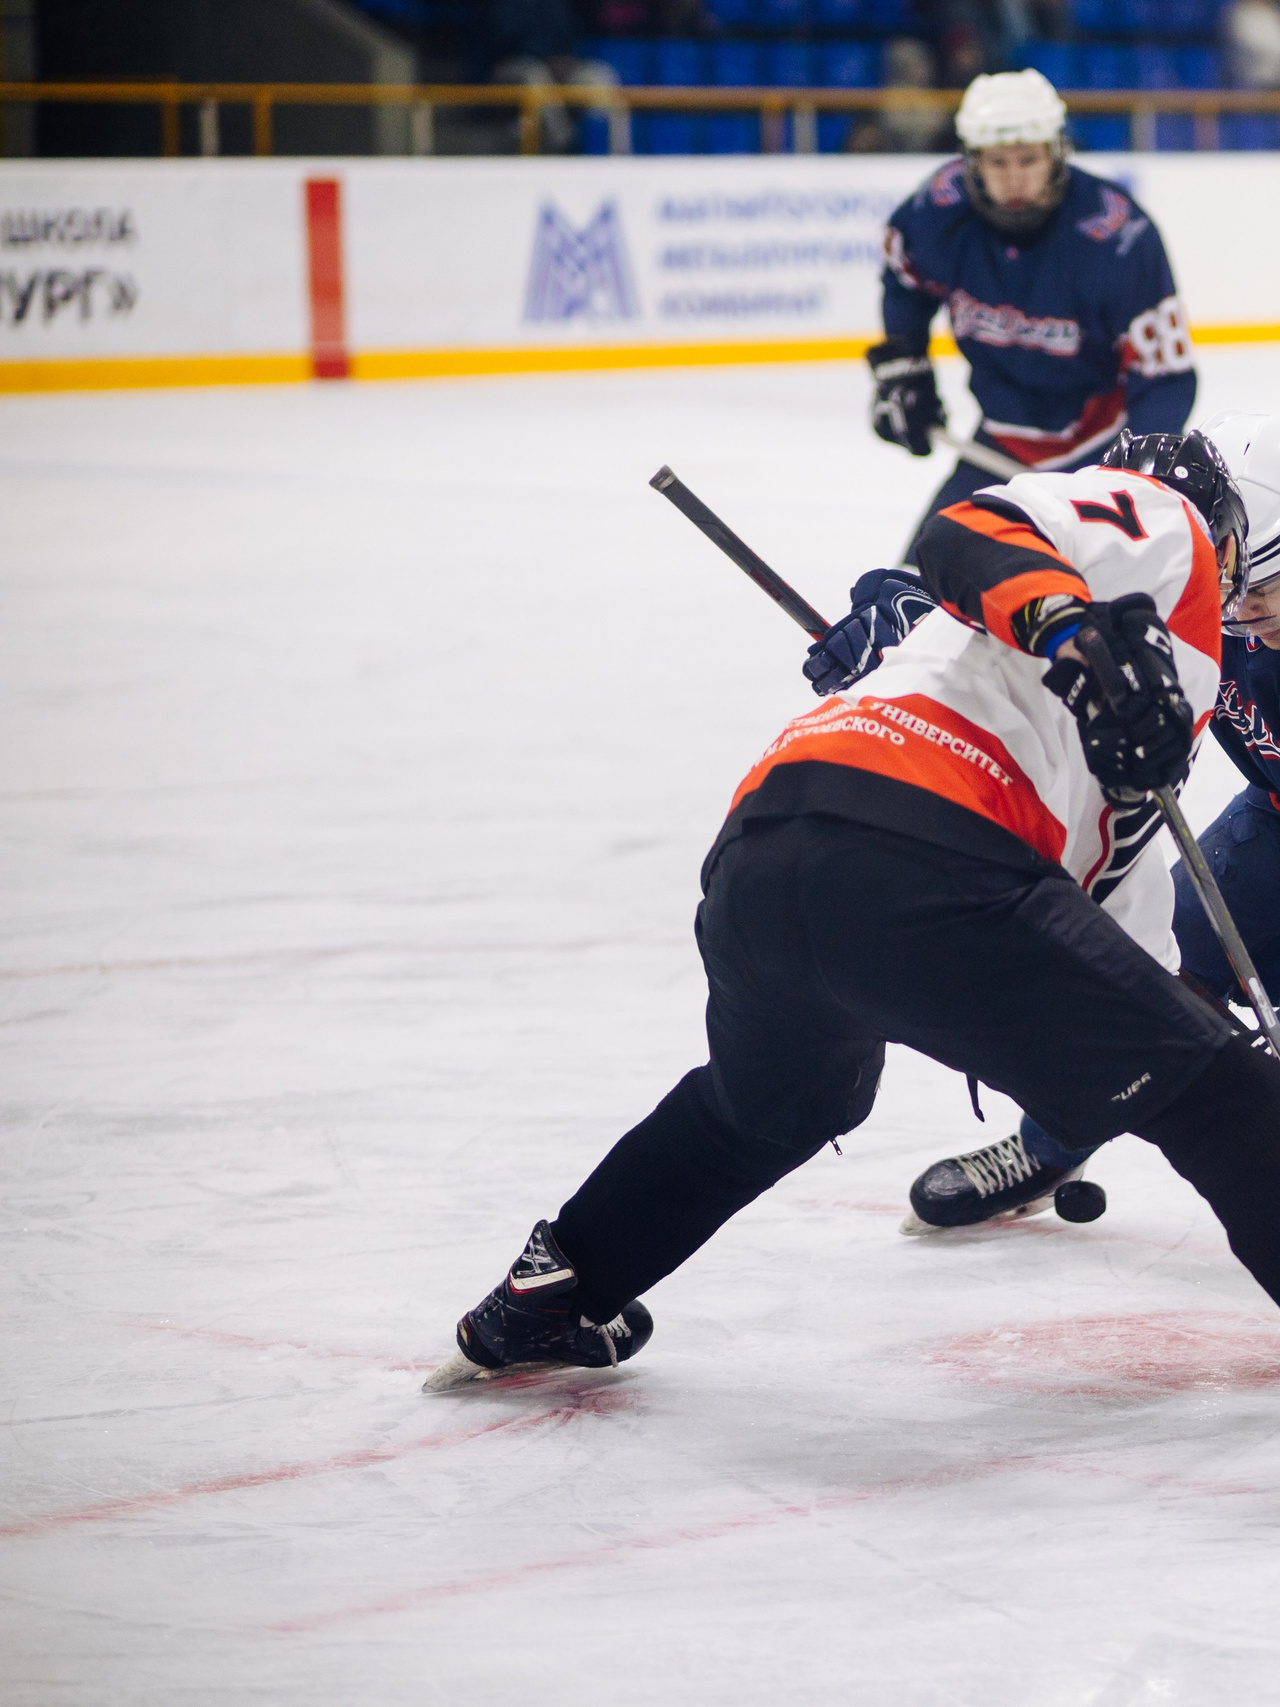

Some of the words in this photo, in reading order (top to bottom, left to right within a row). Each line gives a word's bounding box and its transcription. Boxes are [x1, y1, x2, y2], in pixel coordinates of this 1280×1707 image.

[0, 267, 138, 325] УРГ»
[1069, 490, 1149, 541] 7
[869, 701, 1014, 787] УНИВЕРСИТЕТ
[1110, 1071, 1152, 1101] UER
